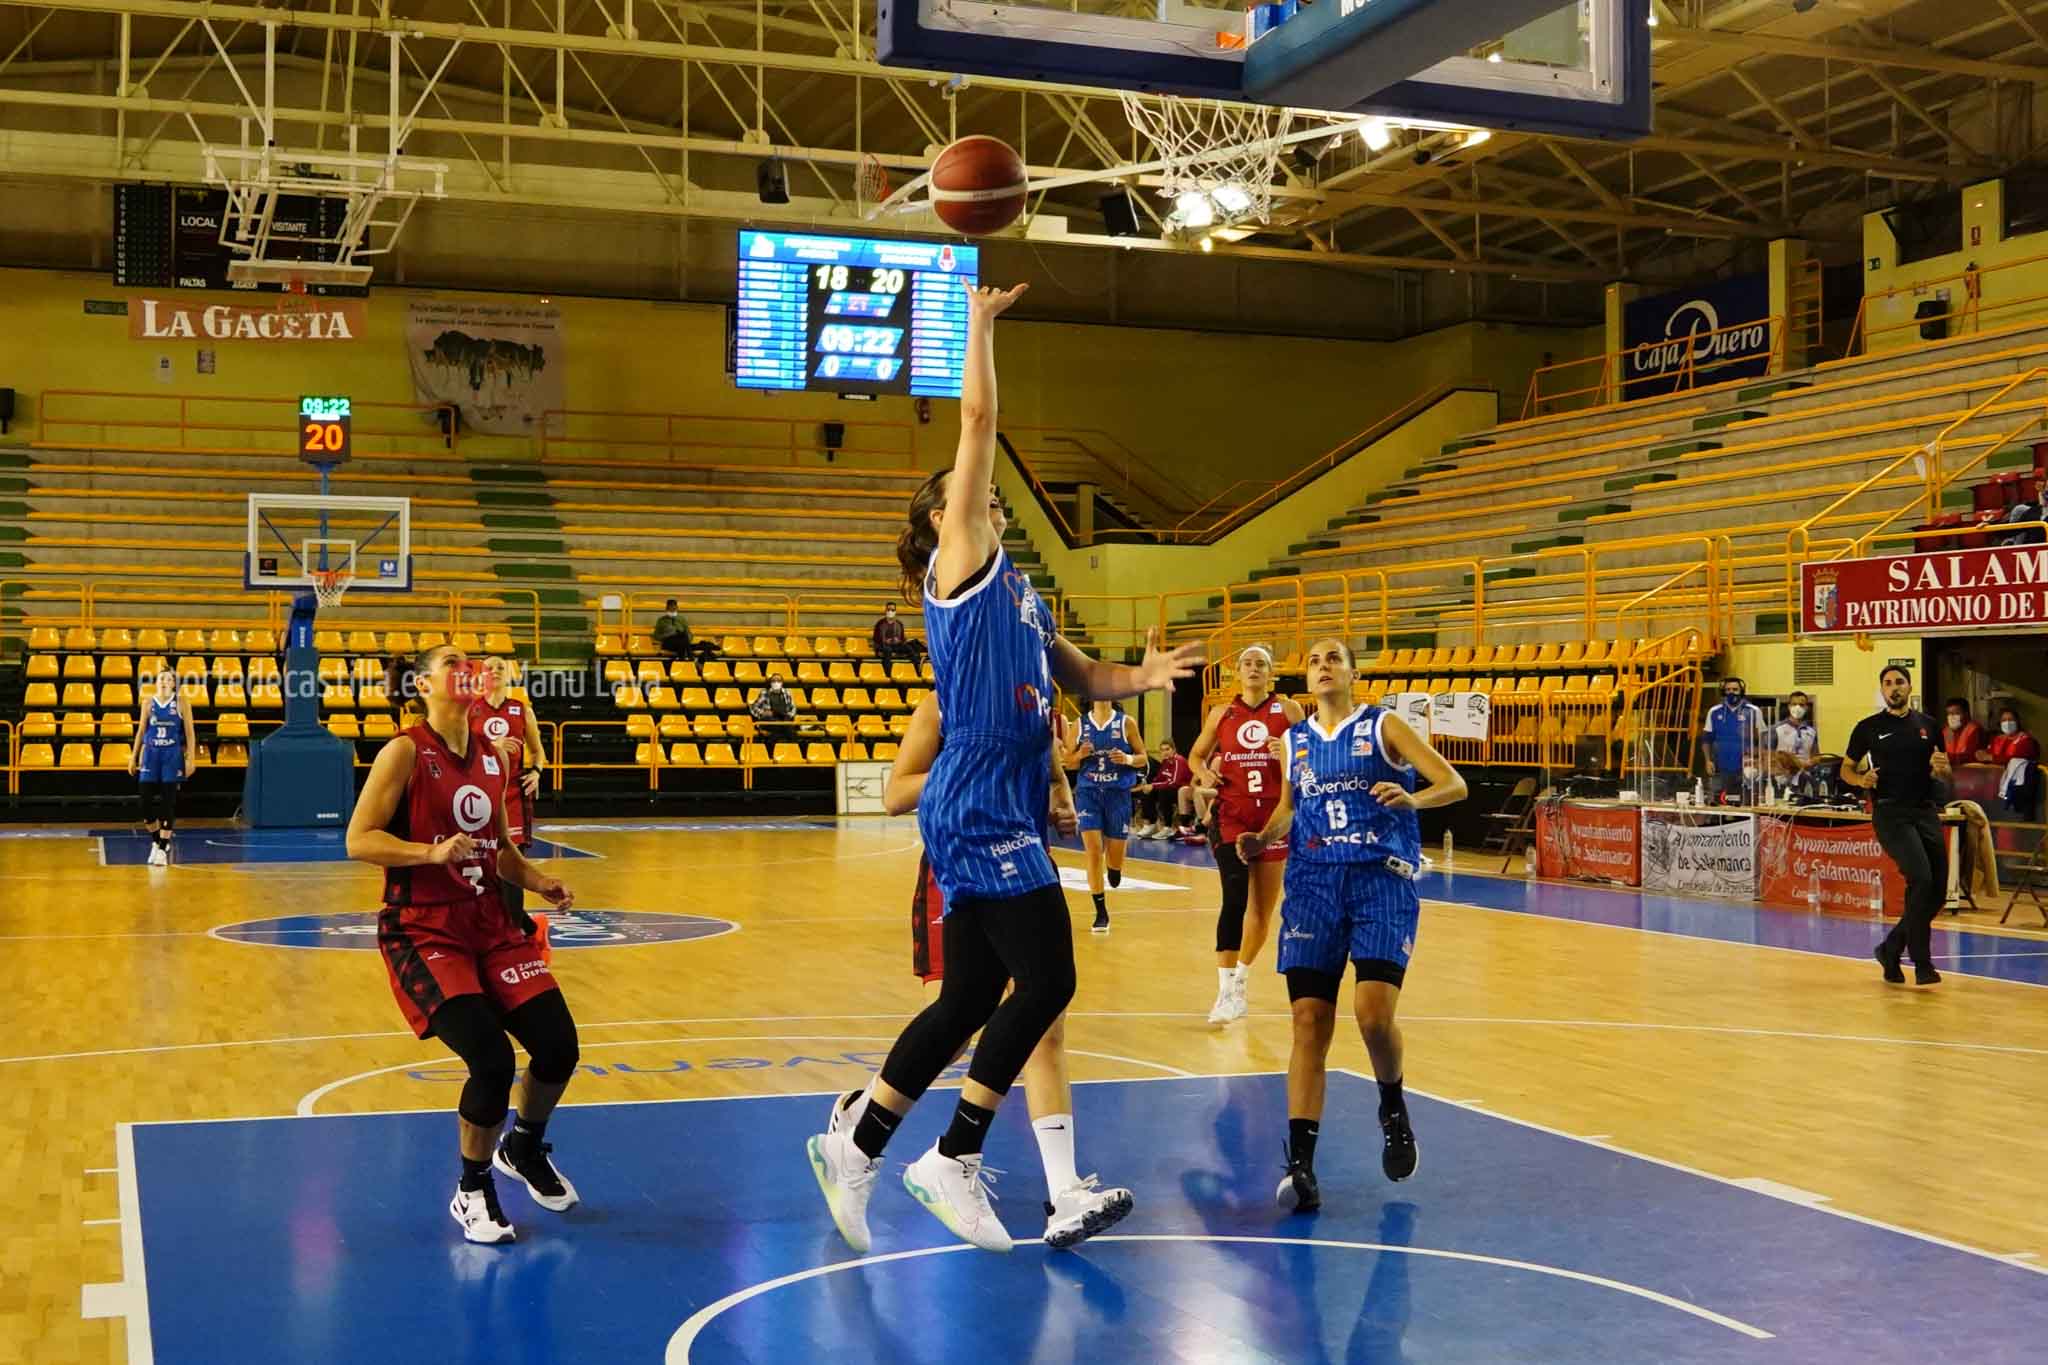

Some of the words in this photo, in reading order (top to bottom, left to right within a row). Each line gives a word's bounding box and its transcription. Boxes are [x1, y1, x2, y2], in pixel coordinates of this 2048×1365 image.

[181, 216, 217, 228] LOCAL
[272, 221, 307, 233] VISITANTE
[180, 278, 206, 287] FALTAS
[816, 265, 848, 291] 18
[870, 268, 905, 294] 20
[142, 300, 197, 337] LA
[202, 304, 352, 338] GACETA
[821, 326, 896, 354] 09:22
[1634, 338, 1680, 374] Caja
[1665, 300, 1764, 365] Duero
[824, 355, 840, 377] 0
[877, 358, 893, 380] 0
[302, 398, 350, 415] 09:22
[305, 424, 344, 451] 20
[1888, 552, 2048, 592] SALAM
[1846, 593, 1992, 627] PATRIMONIO
[1999, 592, 2036, 620] DE
[1099, 757, 1105, 771] 5
[1248, 770, 1263, 792] 2
[1325, 799, 1348, 830] 13
[1571, 823, 1632, 843] Ayuntamiento
[1674, 829, 1751, 850] Ayuntamiento
[1793, 832, 1882, 857] Ayuntamiento
[1583, 843, 1632, 865] Salamanca
[1678, 852, 1690, 870] de
[1692, 852, 1751, 872] Salamanca
[462, 866, 485, 896] 7
[1793, 858, 1808, 877] de
[1811, 859, 1881, 884] Salamanca
